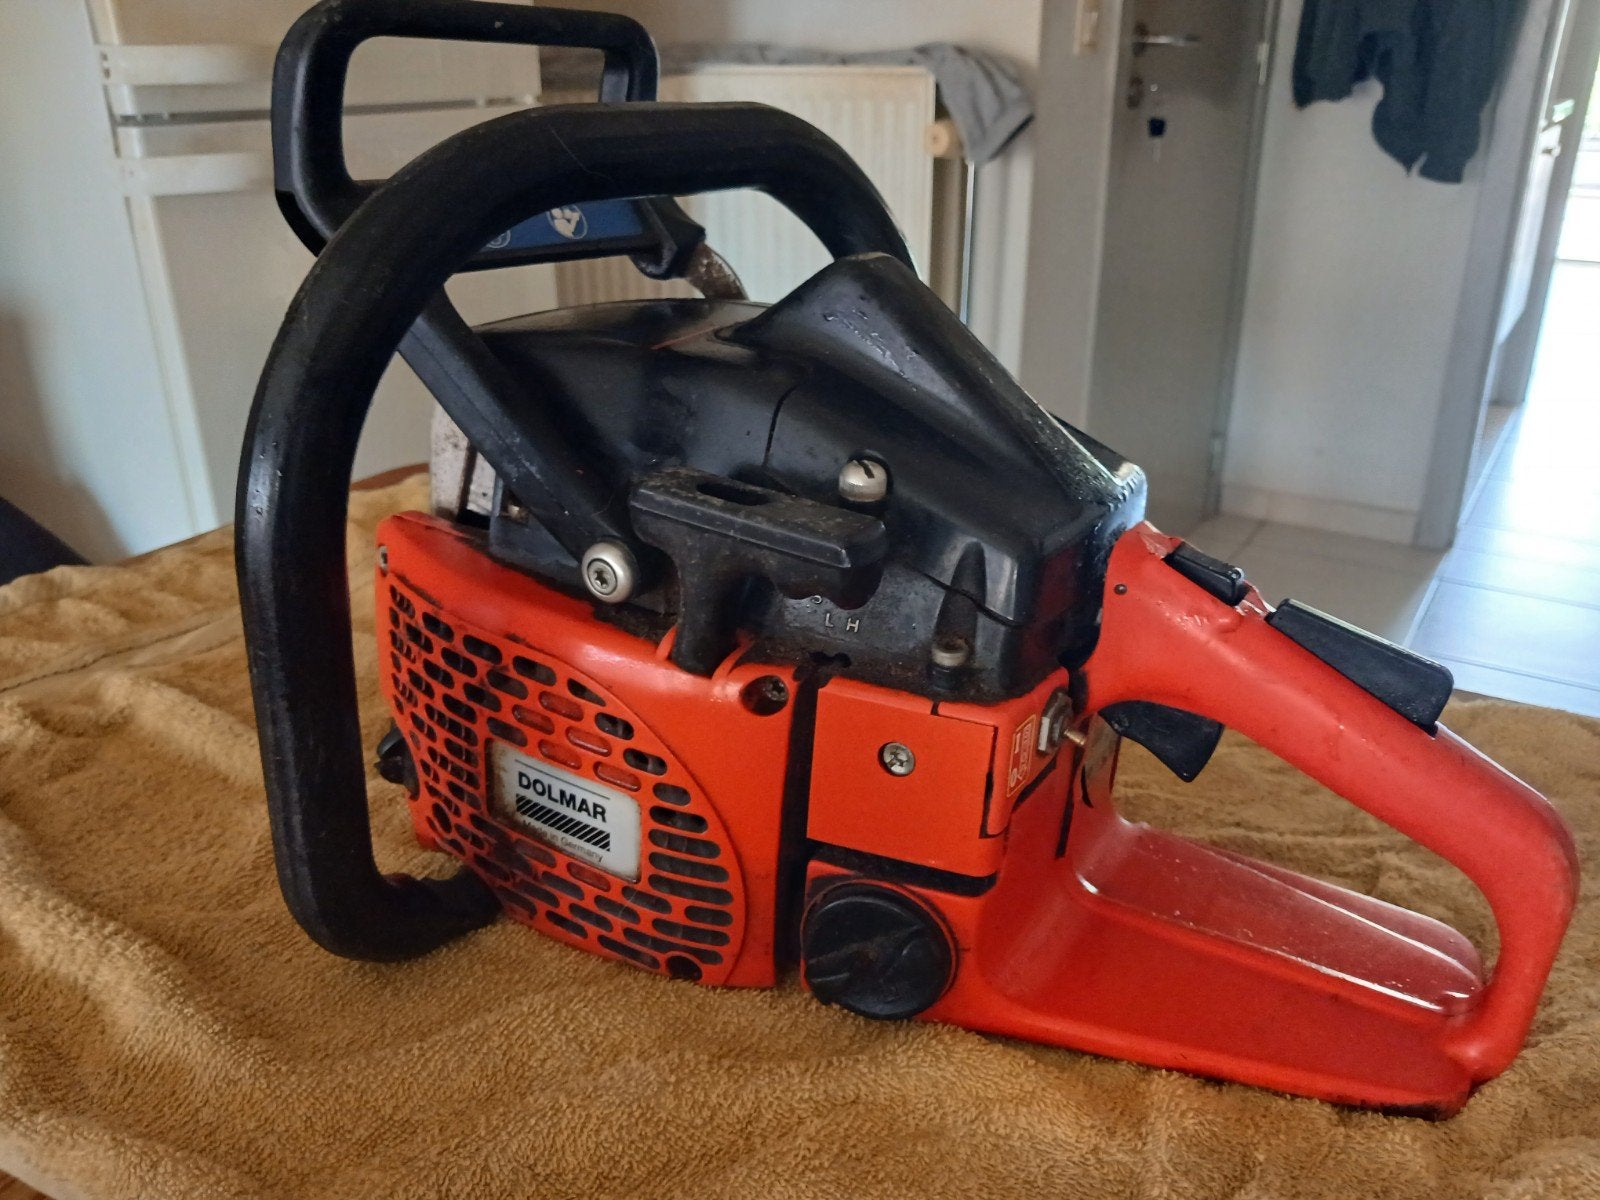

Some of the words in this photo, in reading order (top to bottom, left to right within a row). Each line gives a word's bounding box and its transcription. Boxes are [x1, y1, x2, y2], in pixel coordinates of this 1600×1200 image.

[825, 613, 834, 627] L
[846, 618, 860, 632] H
[518, 771, 607, 823] DOLMAR
[560, 836, 604, 862] Germany
